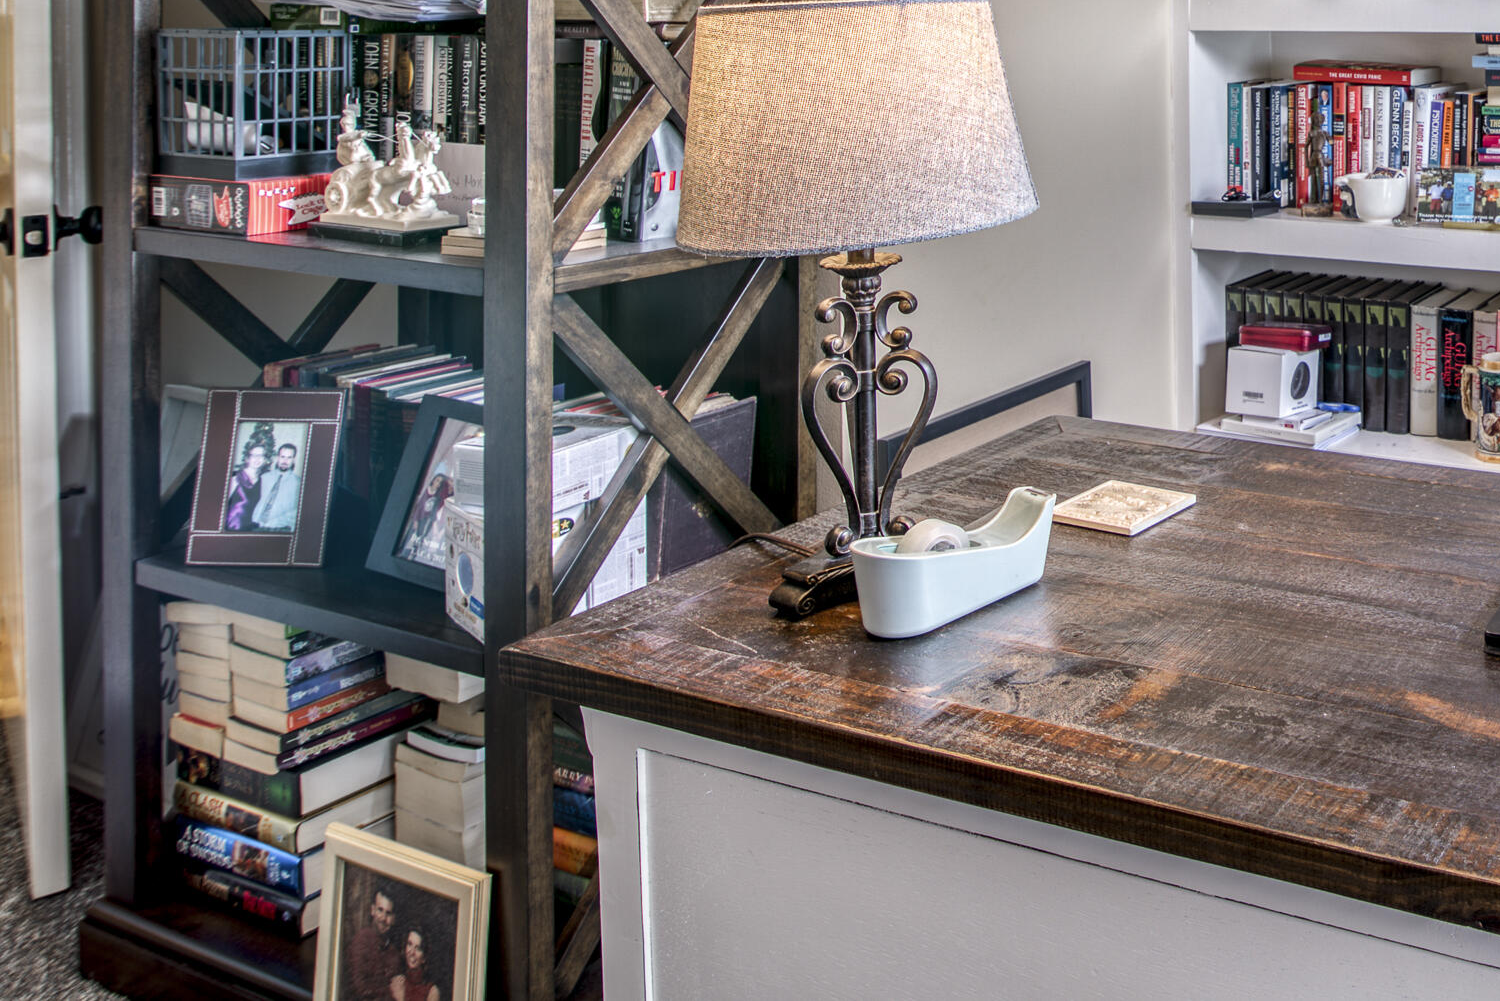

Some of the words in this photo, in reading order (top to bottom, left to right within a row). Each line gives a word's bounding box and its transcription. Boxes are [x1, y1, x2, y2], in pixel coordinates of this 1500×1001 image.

[364, 41, 379, 69] JOHN
[585, 46, 595, 88] MICHAEL
[438, 72, 446, 114] GRISHAM
[581, 93, 593, 142] CRICHTON
[1298, 110, 1306, 144] DECEPTION
[1412, 324, 1425, 381] Archipelago
[1425, 337, 1436, 381] GULAG
[1441, 328, 1455, 387] Archipelago
